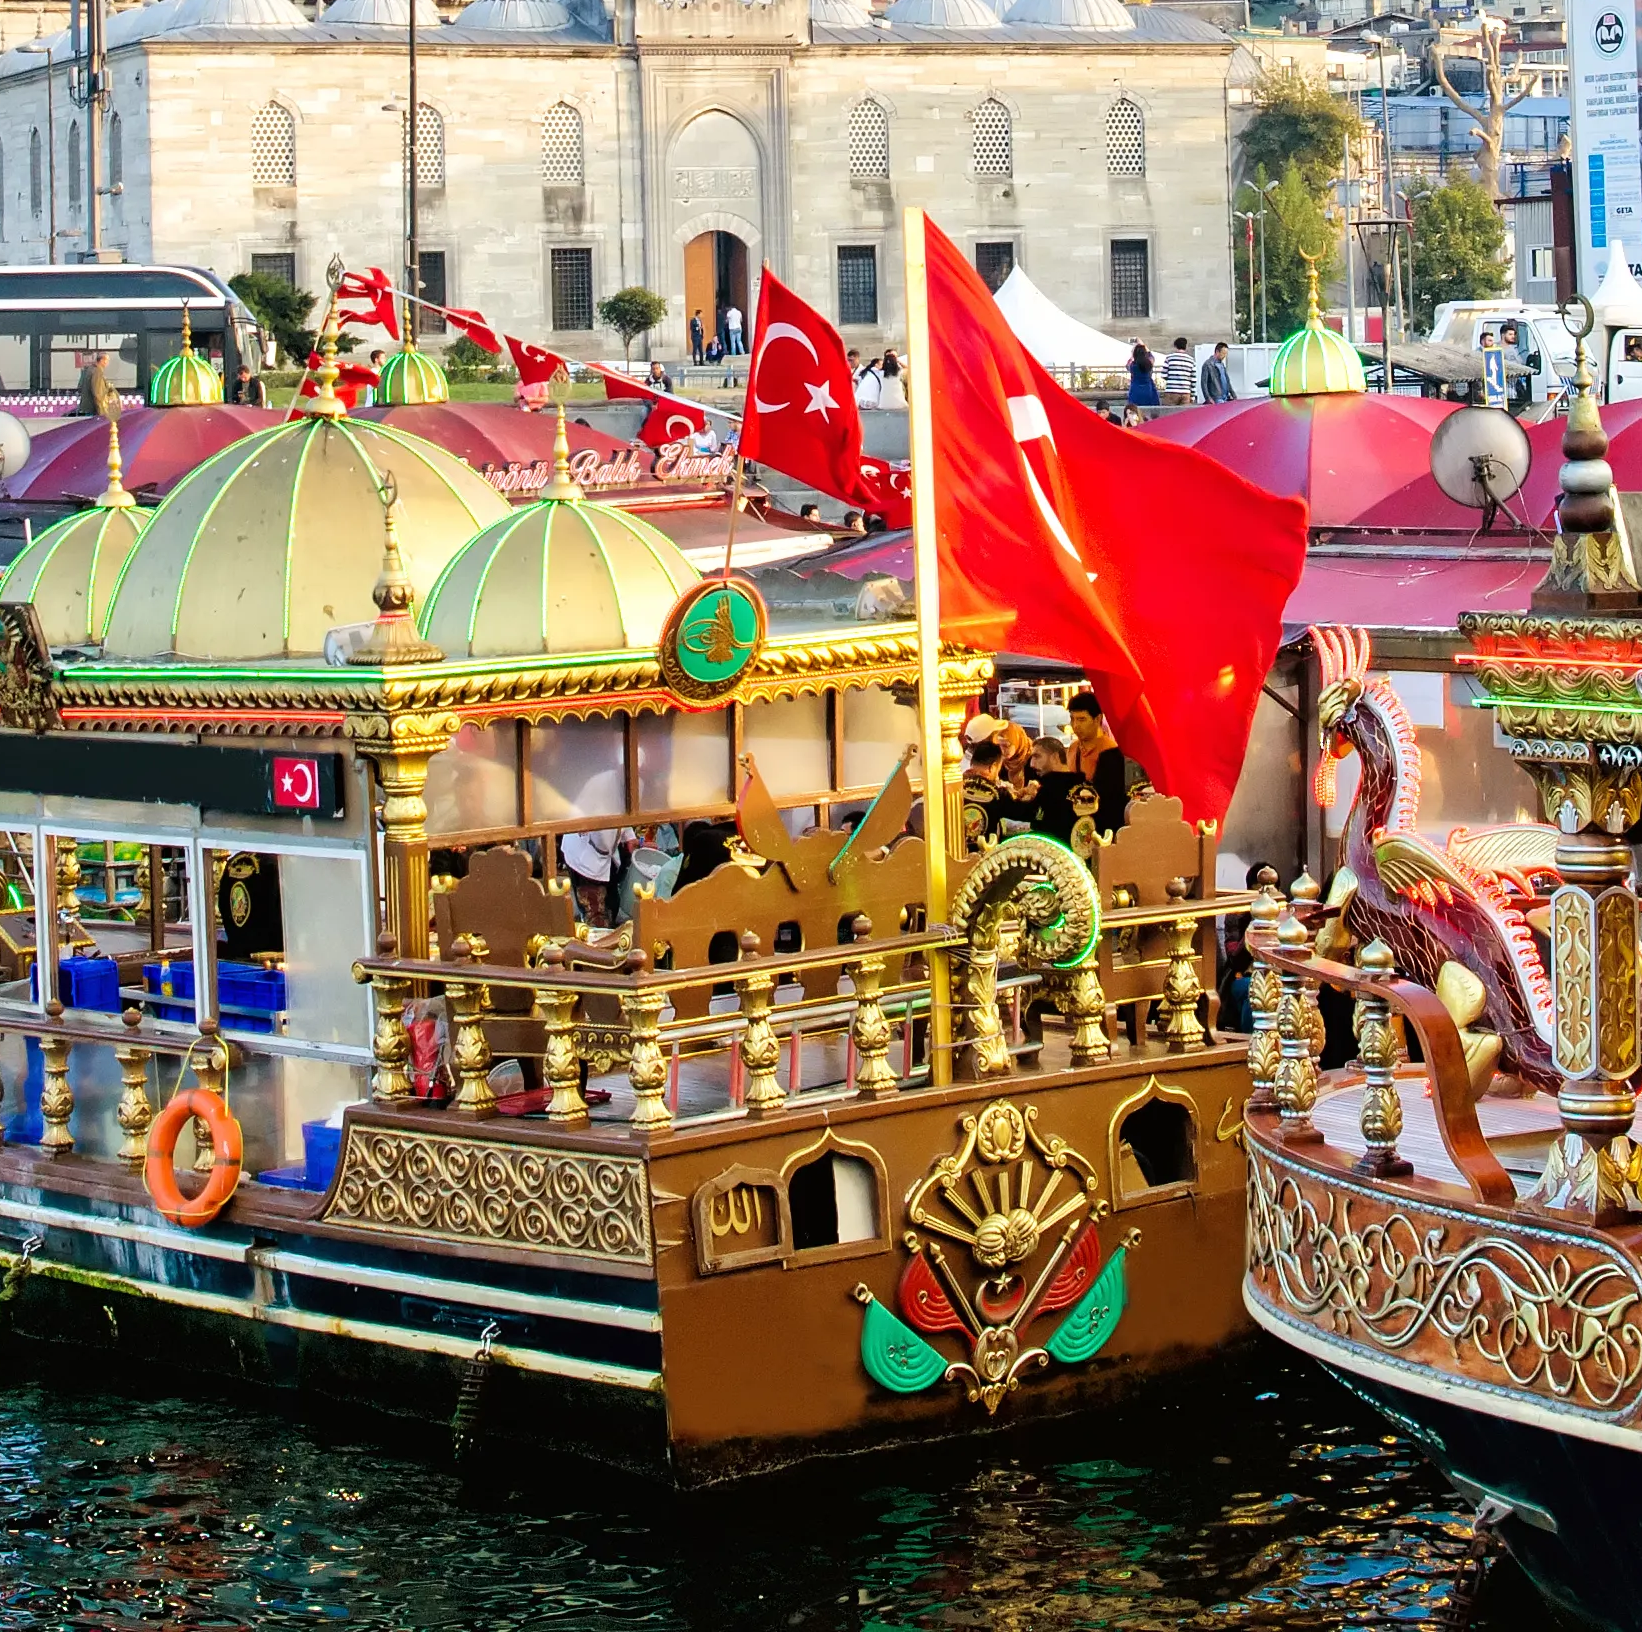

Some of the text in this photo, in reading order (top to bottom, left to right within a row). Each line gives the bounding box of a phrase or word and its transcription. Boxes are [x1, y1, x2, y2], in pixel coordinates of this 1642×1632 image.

[1628, 264, 1642, 276] TA
[569, 448, 641, 485] Balık
[654, 443, 736, 479] Ekmek
